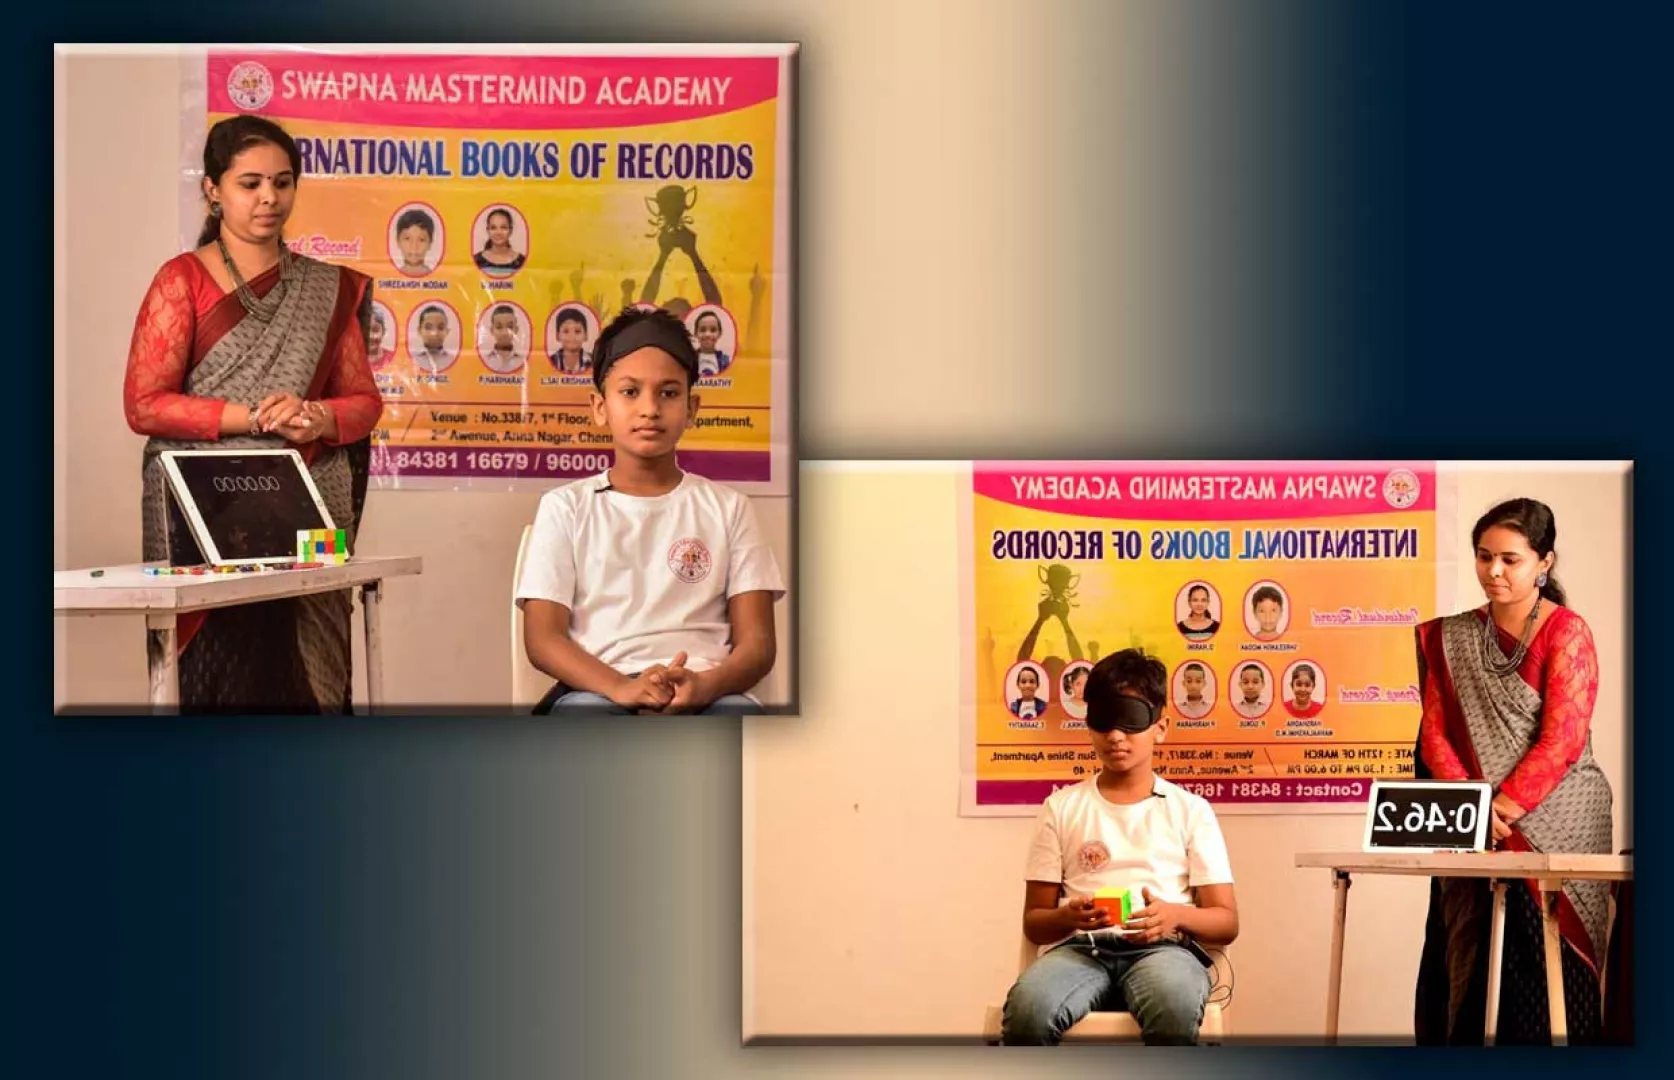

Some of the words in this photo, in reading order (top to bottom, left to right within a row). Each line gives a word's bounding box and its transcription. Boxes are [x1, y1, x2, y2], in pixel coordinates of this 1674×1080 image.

[281, 70, 399, 101] SWAPNA
[405, 73, 586, 106] MASTERMIND
[595, 76, 733, 106] ACADEMY
[294, 138, 452, 176] RNATIONAL
[461, 141, 560, 178] BOOKS
[570, 142, 609, 180] OF
[617, 143, 754, 181] RECORDS
[310, 235, 361, 254] Record
[430, 411, 468, 423] Venue
[557, 413, 592, 426] Floor,
[694, 415, 754, 429] partment,
[503, 431, 534, 441] Anna
[537, 432, 575, 445] Nagar,
[397, 451, 458, 469] 84381
[467, 452, 528, 470] 16679
[546, 453, 610, 471] 96000
